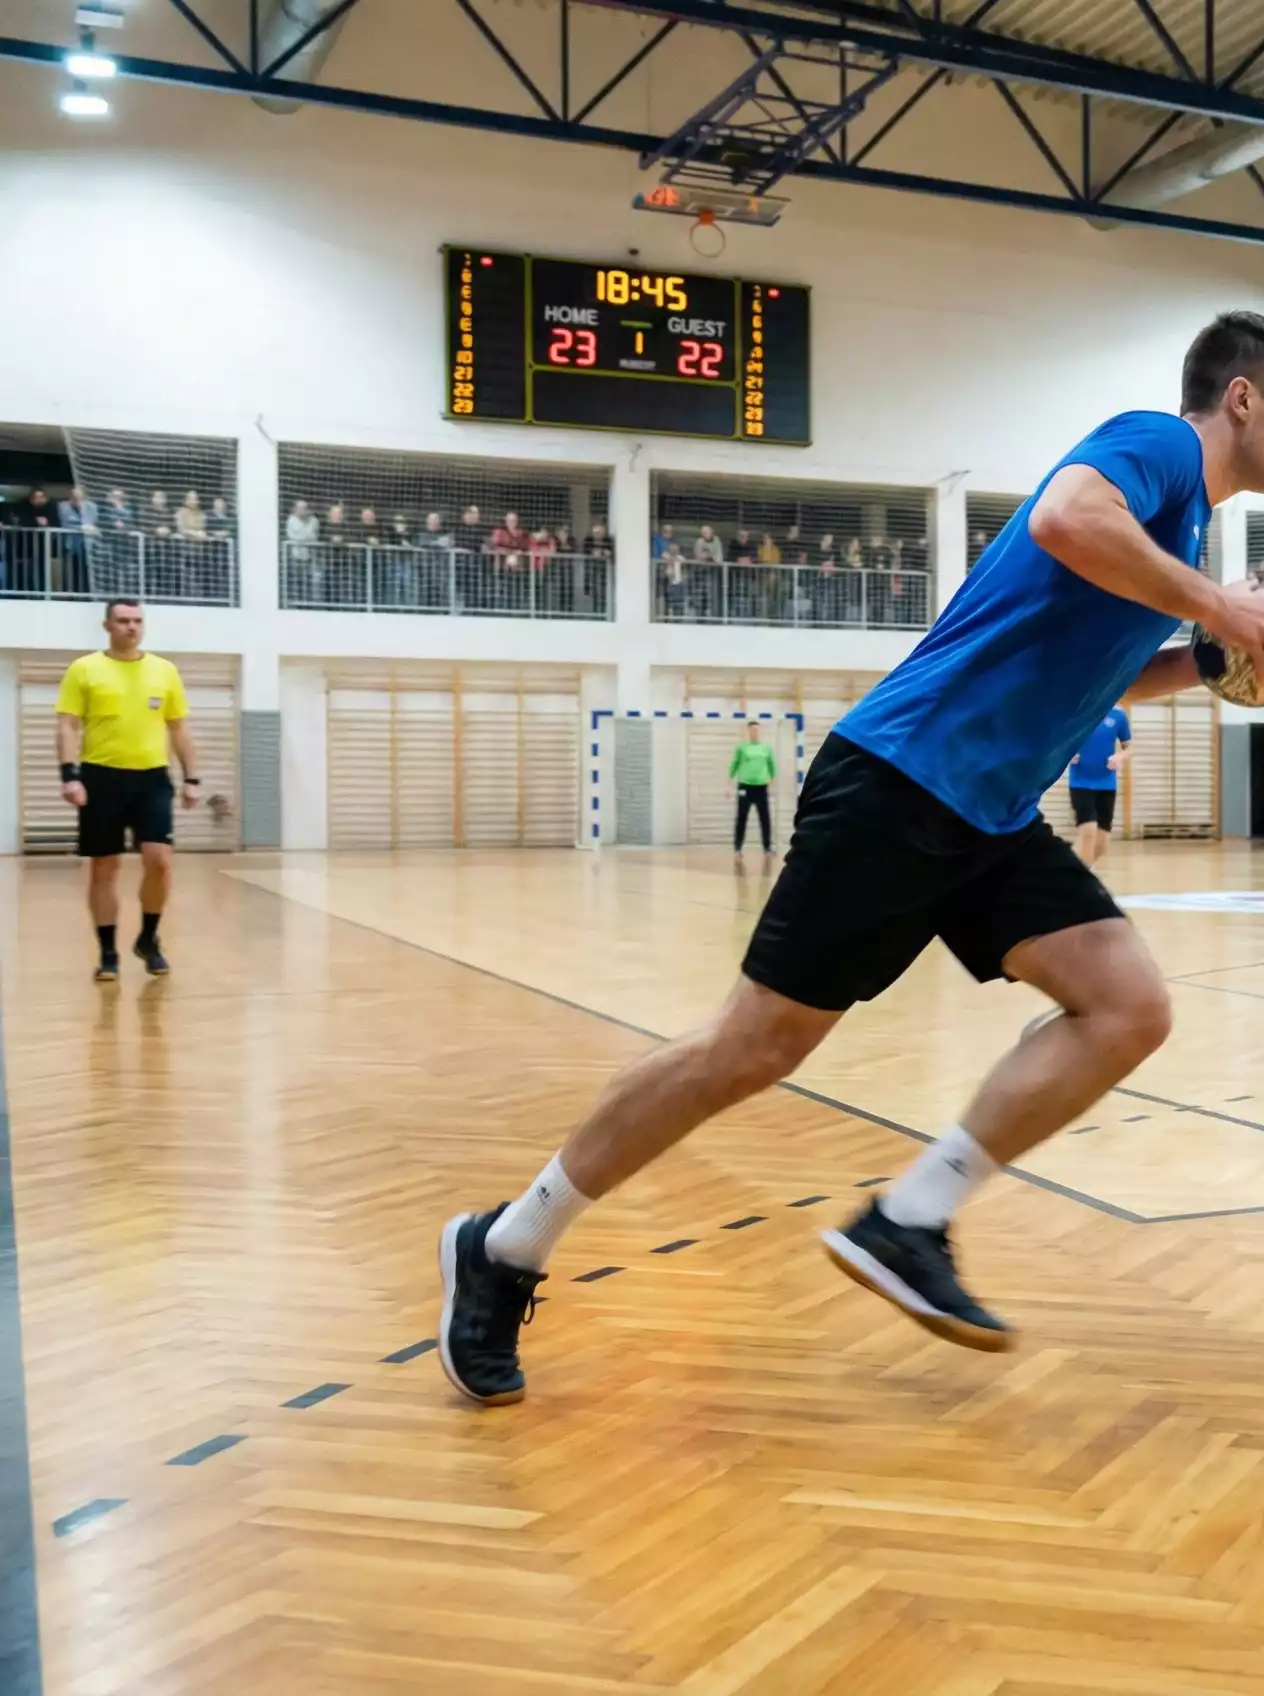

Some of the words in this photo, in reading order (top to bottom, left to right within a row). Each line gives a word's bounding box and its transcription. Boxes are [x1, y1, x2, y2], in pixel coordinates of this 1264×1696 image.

[596, 270, 688, 312] 18:45
[544, 304, 599, 326] HOME
[667, 316, 727, 338] GUEST
[549, 328, 597, 366] 23
[677, 340, 723, 379] 22
